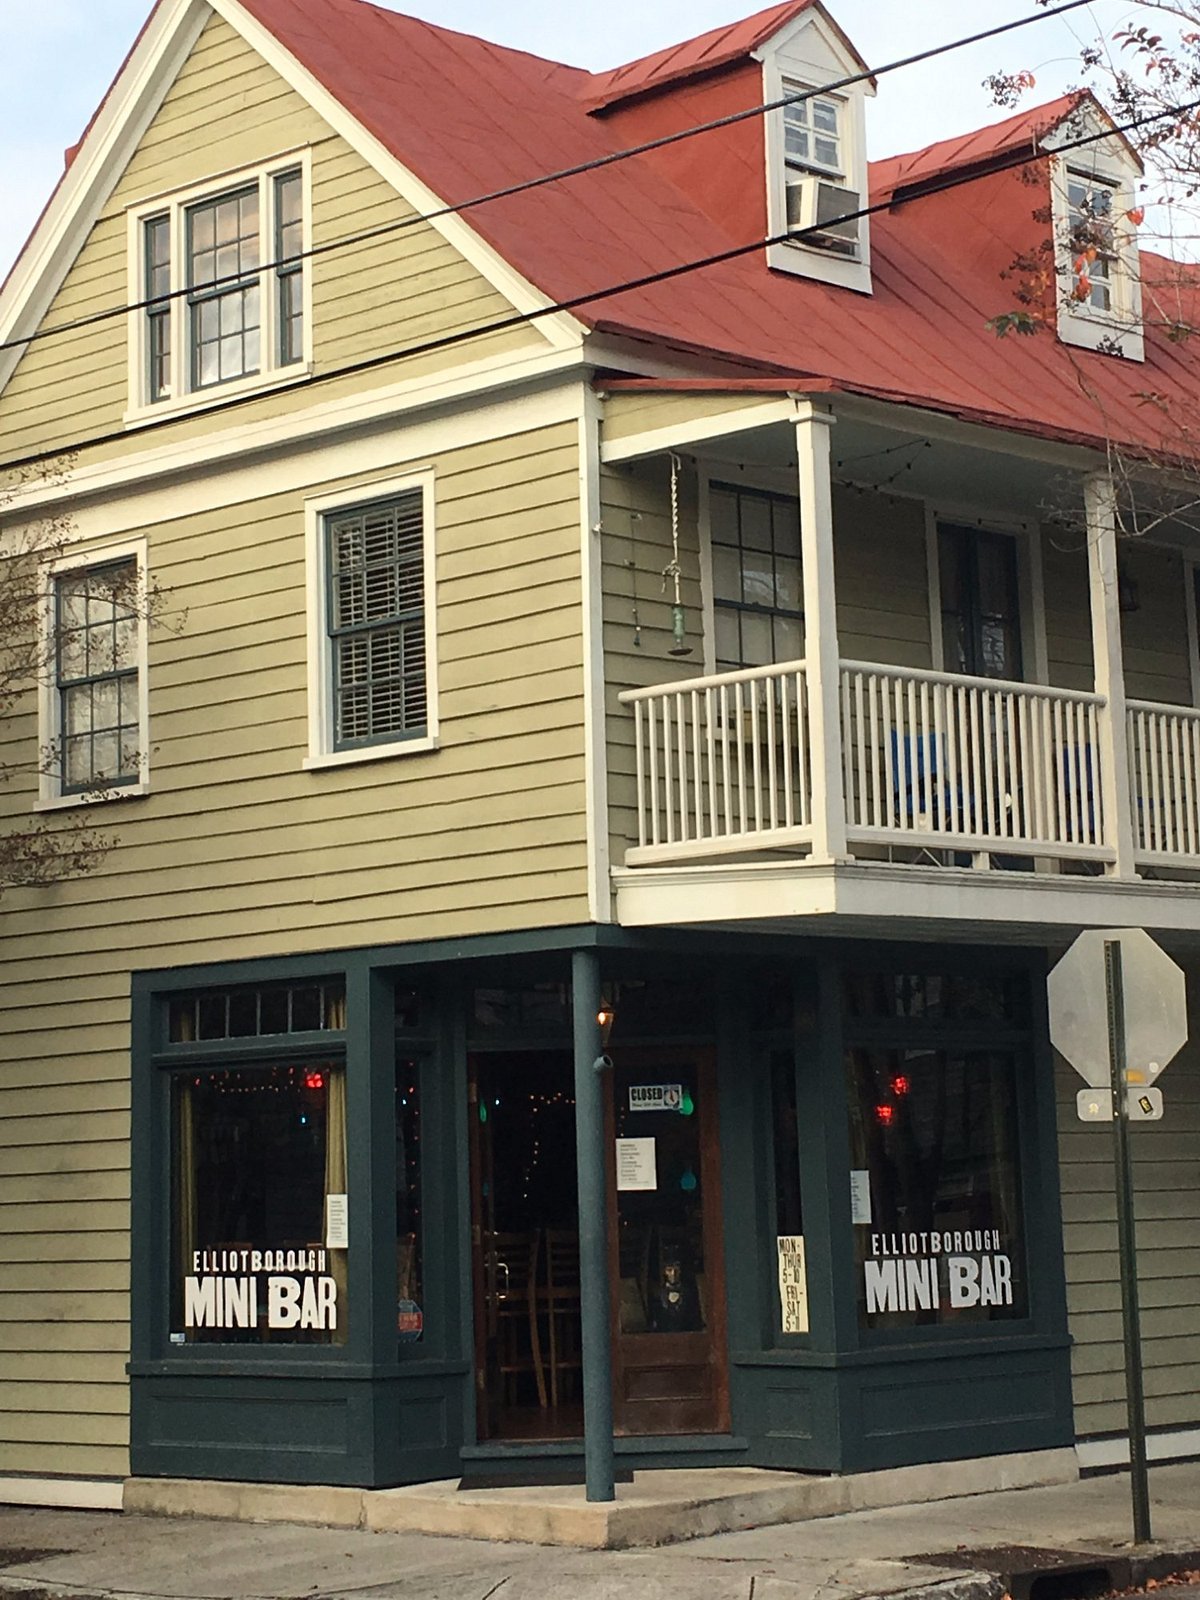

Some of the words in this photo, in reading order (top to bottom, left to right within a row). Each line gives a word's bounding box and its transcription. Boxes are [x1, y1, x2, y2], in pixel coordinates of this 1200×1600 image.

[631, 1087, 663, 1101] CLOSED
[871, 1229, 1001, 1256] ELLIOTBOROUGH
[193, 1250, 326, 1272] ELLIOTBOROUGH
[864, 1257, 940, 1314] MINI
[948, 1254, 1013, 1309] BAR
[185, 1276, 257, 1328] MINI
[268, 1276, 337, 1329] BAR
[786, 1301, 801, 1317] SAT
